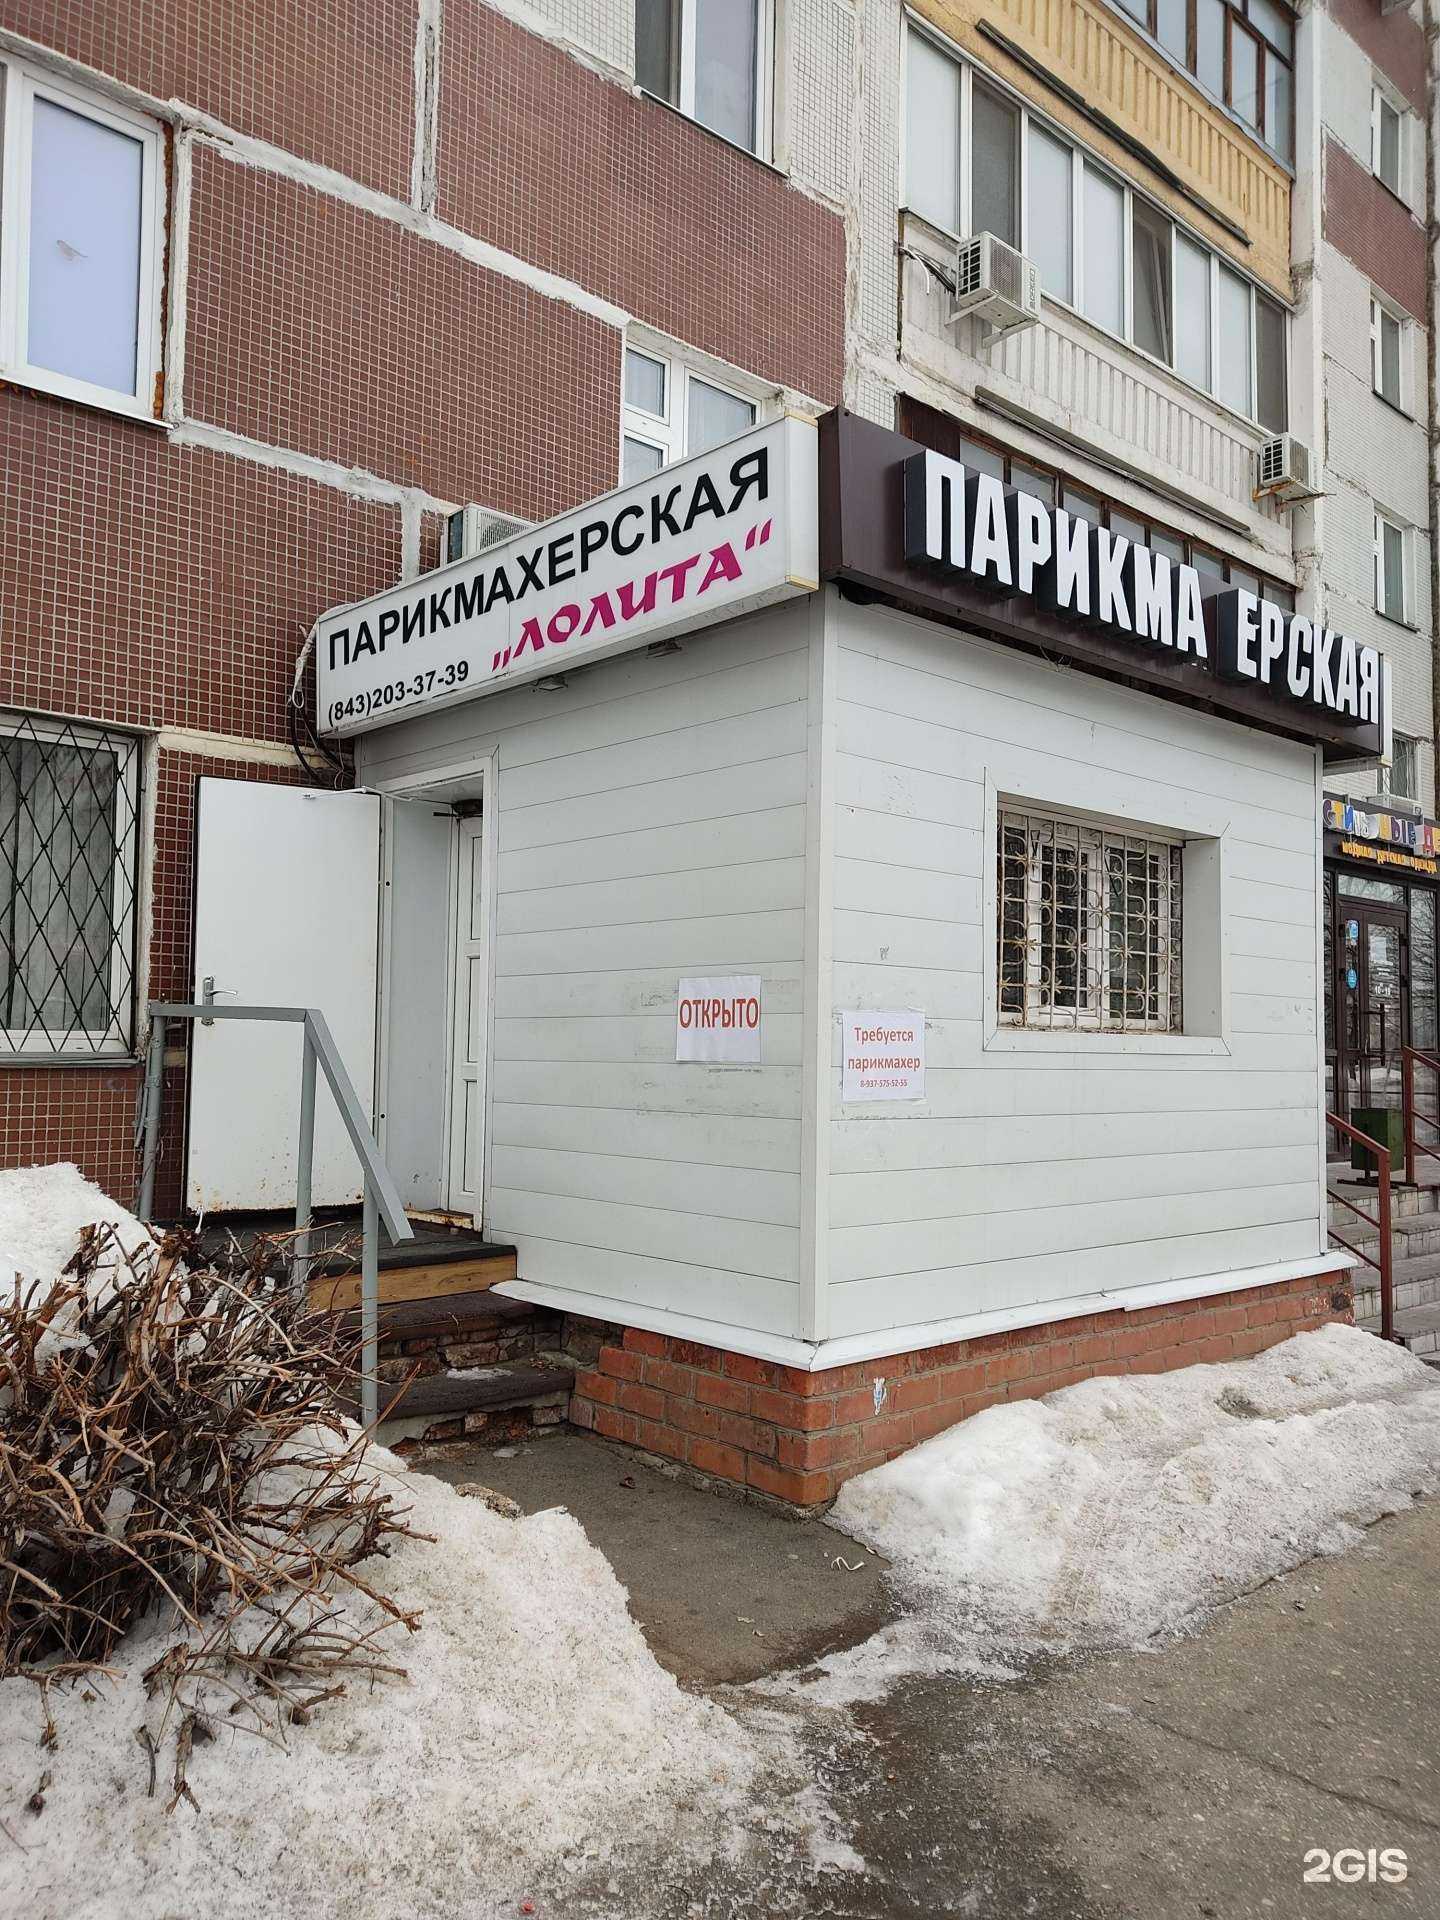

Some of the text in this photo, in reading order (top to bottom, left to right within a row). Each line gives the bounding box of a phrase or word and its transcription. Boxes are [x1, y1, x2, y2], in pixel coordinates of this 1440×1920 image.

[328, 446, 769, 670] ПАРИКМАХЕРСКАЯ
[328, 660, 469, 727] (843)203-37-39
[679, 997, 759, 1029] ОТКРЫТО
[854, 1026, 914, 1046] Требуется
[848, 1054, 921, 1072] парикмахер
